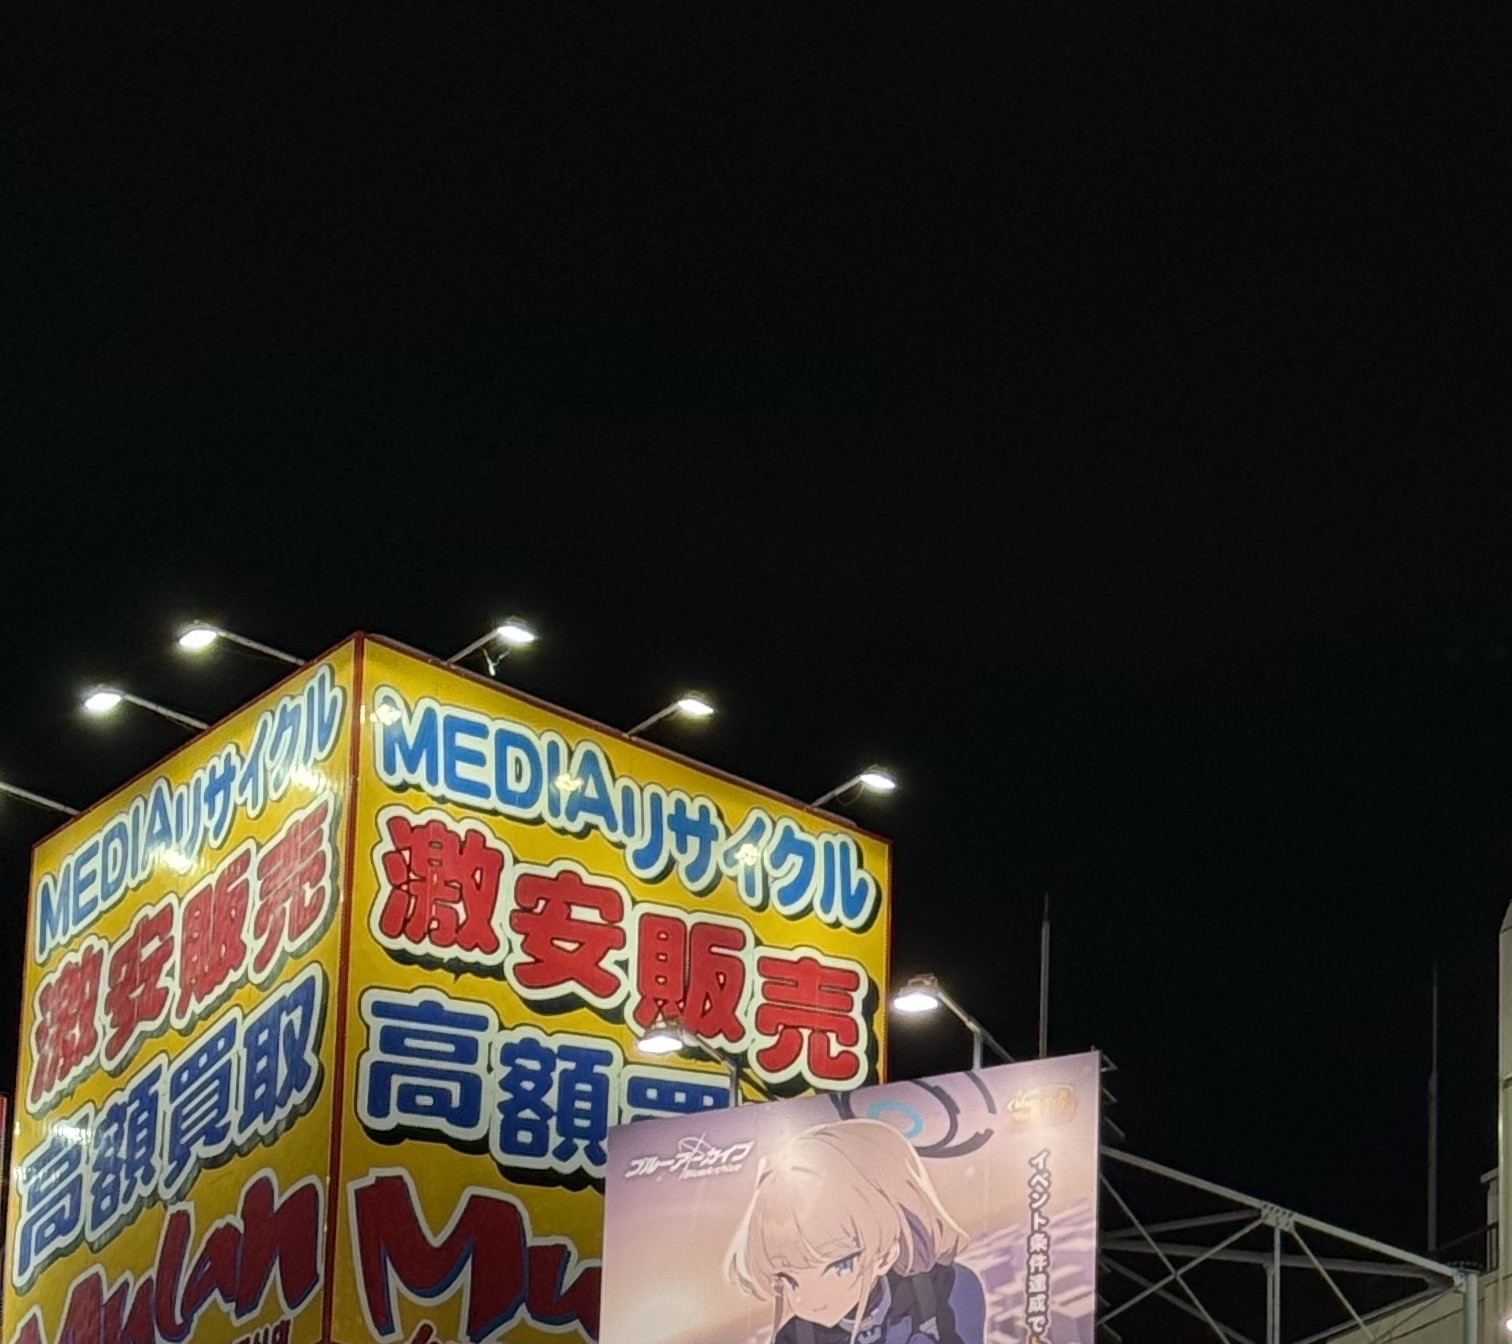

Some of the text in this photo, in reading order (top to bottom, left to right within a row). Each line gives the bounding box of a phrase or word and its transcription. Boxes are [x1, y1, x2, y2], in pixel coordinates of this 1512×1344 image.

[37, 667, 345, 960] MEDIAリサイクル
[378, 690, 875, 922] MEDIAリサイクル
[378, 812, 866, 1086] 激安販売
[30, 806, 336, 1106] 激安販売
[17, 970, 323, 1284] 高額買取
